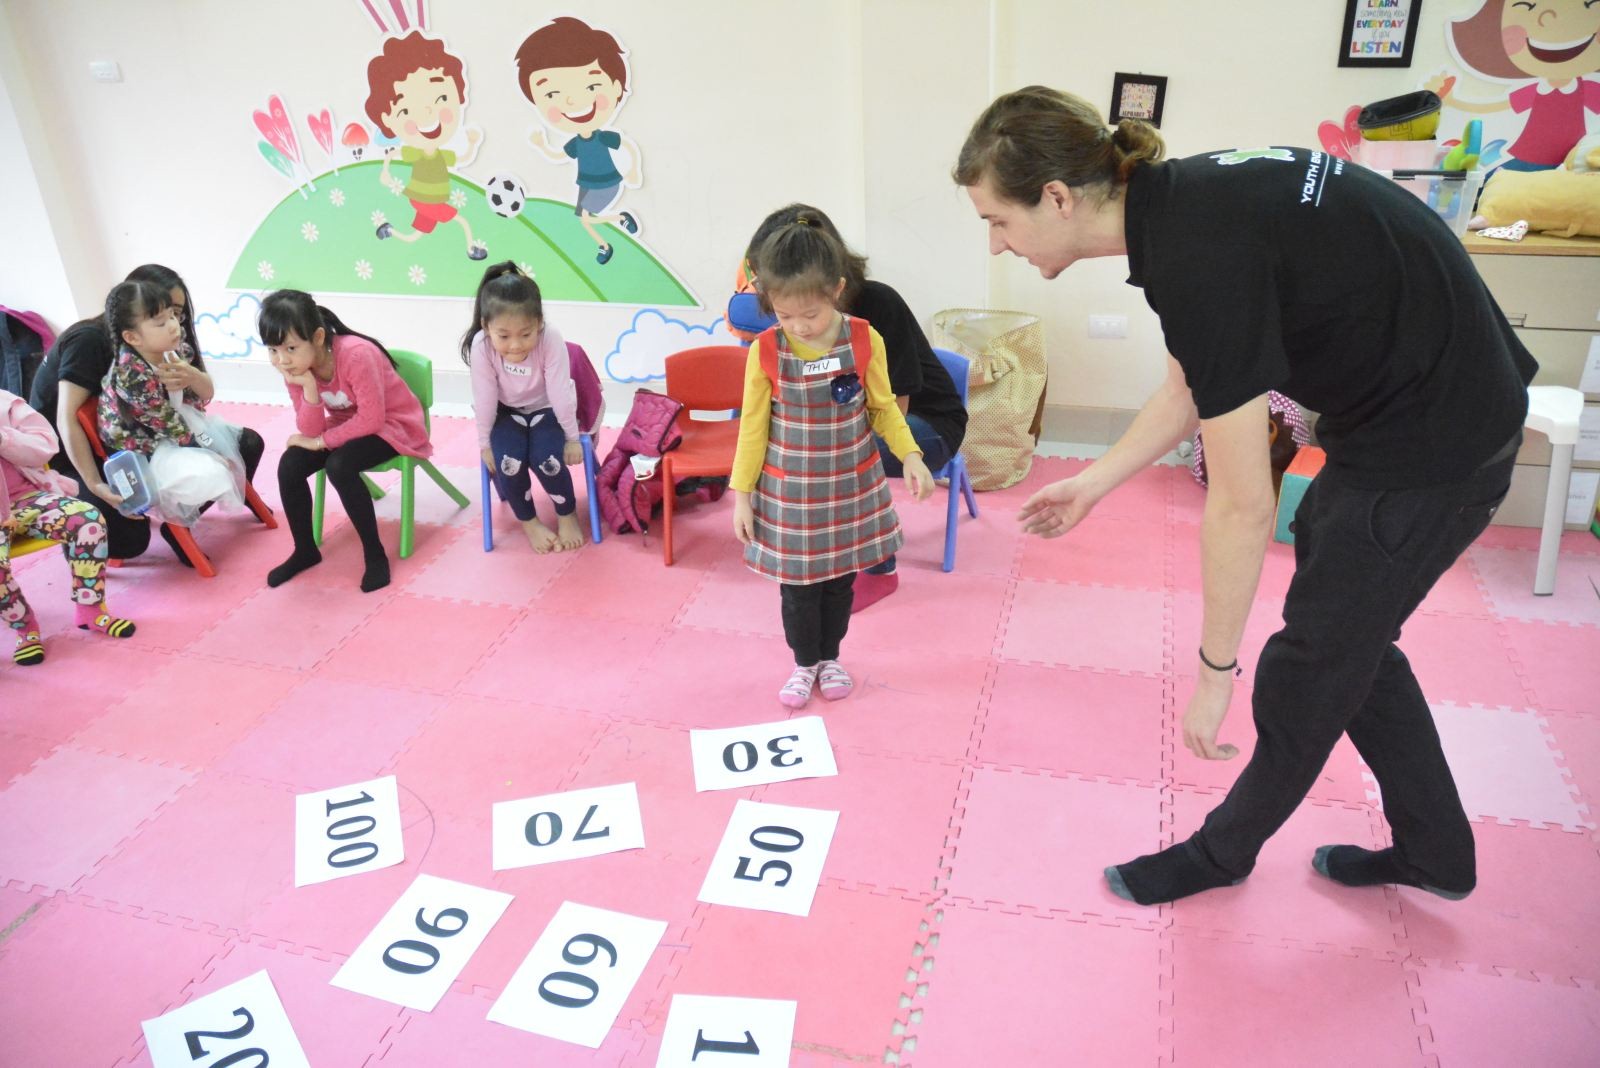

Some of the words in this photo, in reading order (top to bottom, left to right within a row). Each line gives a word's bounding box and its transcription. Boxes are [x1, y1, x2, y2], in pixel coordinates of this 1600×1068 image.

[1367, 0, 1398, 8] LEARN
[1356, 19, 1404, 29] EVERYDAY
[1351, 40, 1402, 54] LISTEN
[1300, 164, 1320, 203] YOUTH
[723, 735, 803, 772] 30
[326, 791, 379, 868] 100
[525, 804, 610, 847] 70
[734, 825, 804, 888] 50
[382, 907, 469, 974] 90
